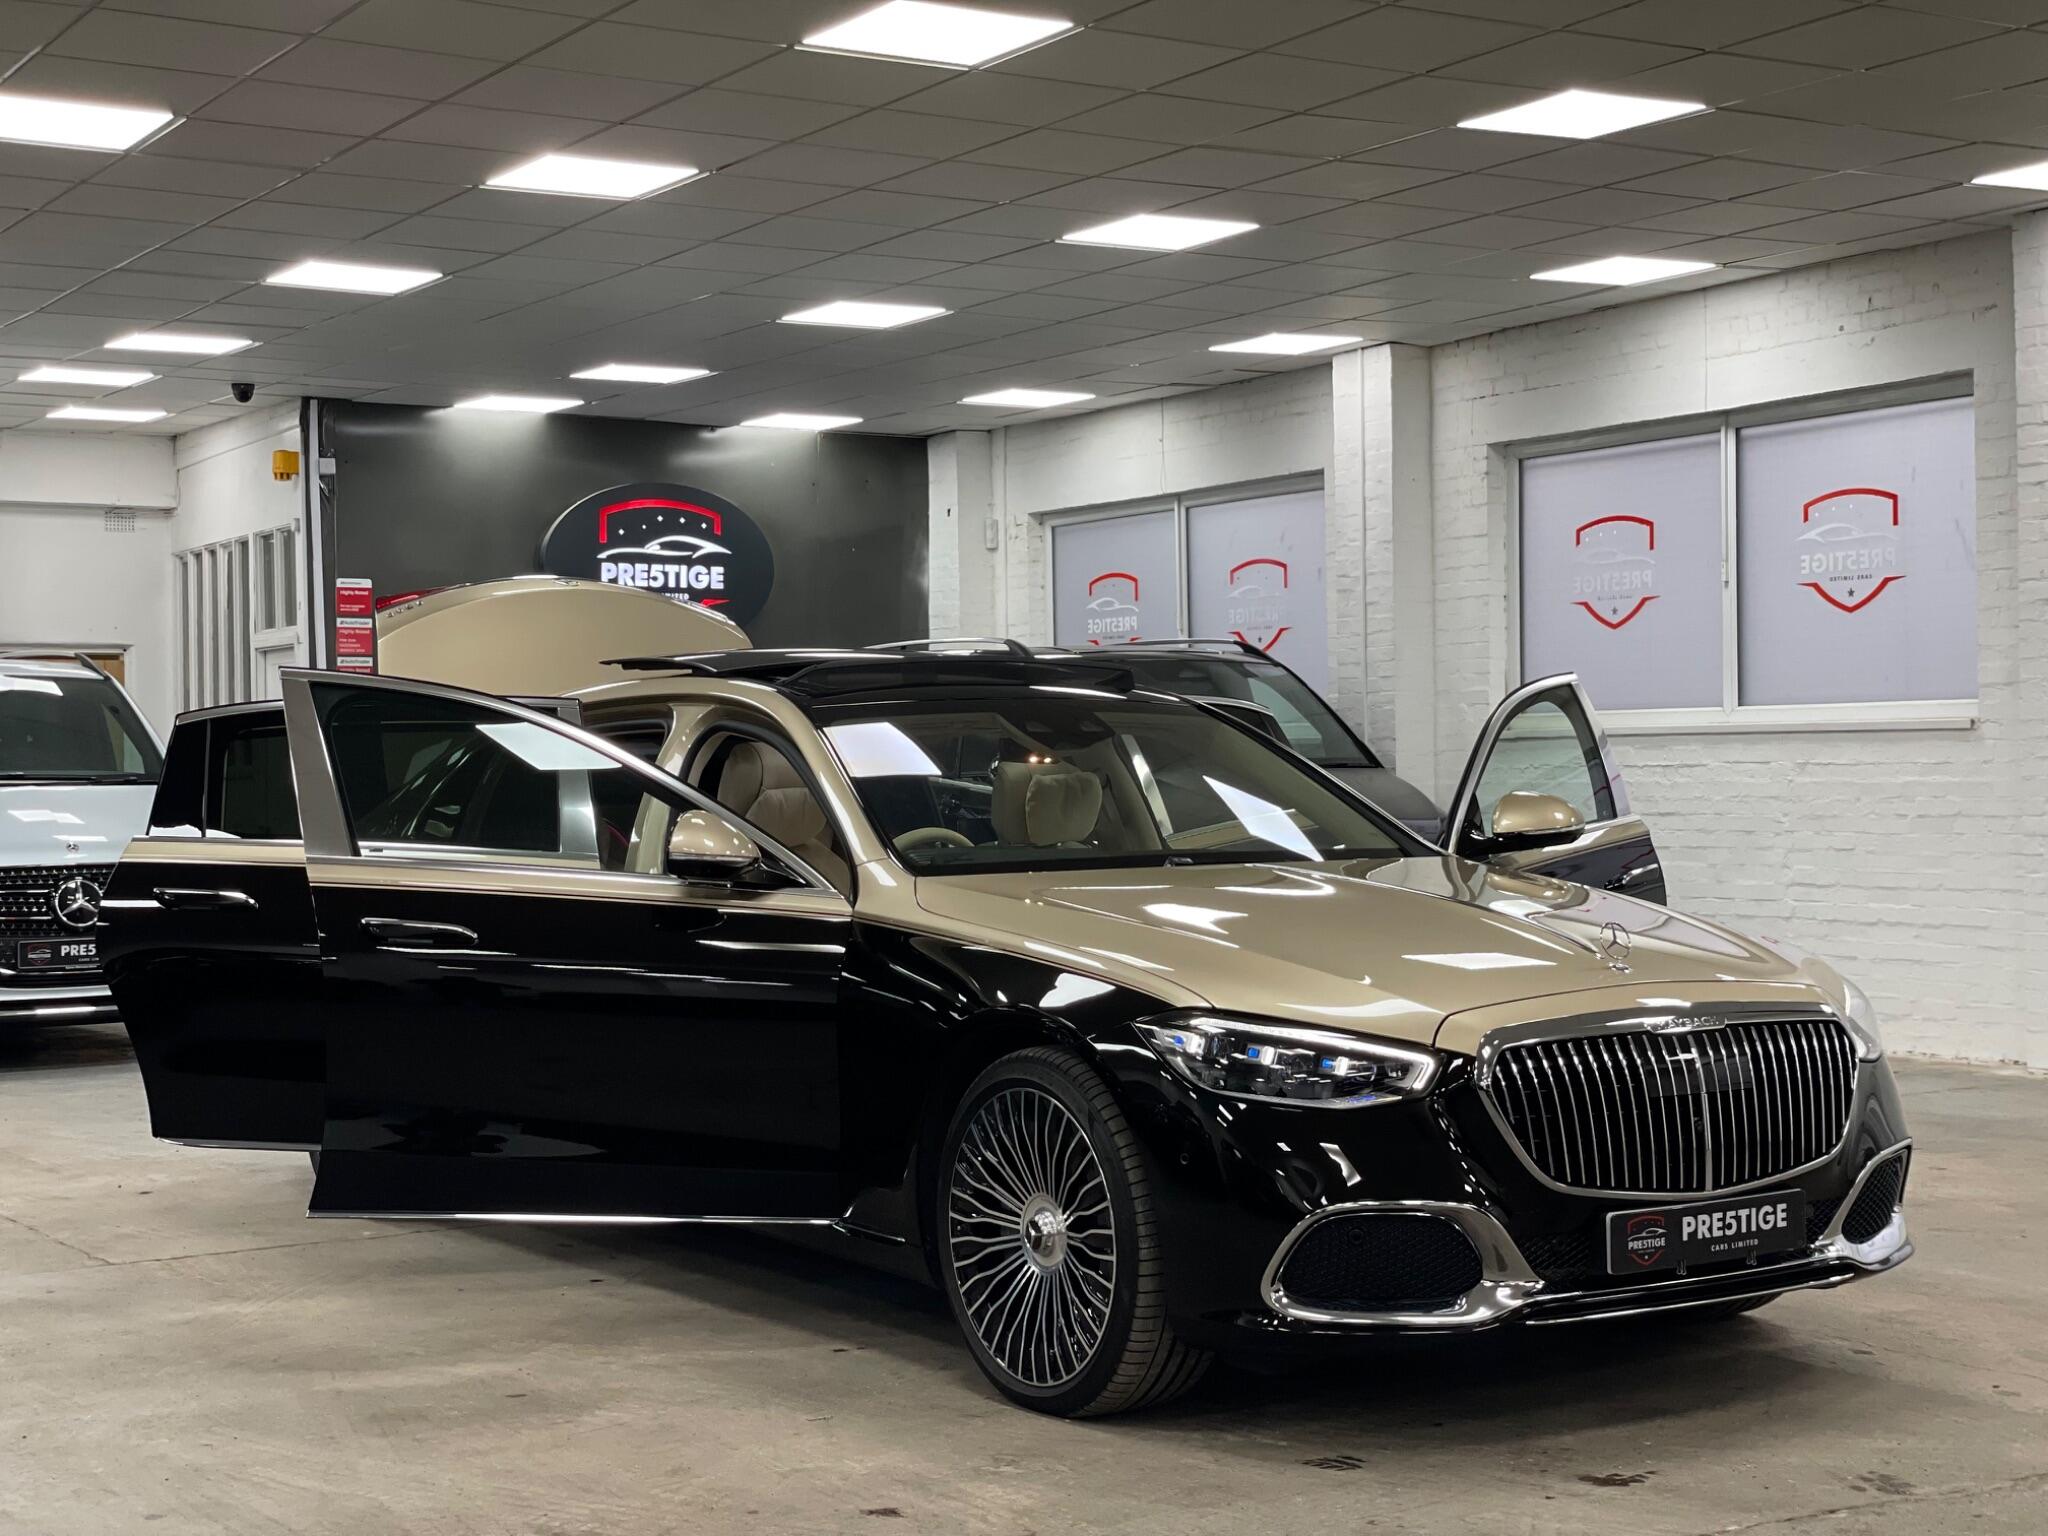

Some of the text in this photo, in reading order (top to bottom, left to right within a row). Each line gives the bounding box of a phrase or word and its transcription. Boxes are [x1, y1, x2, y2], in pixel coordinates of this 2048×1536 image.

[600, 562, 724, 589] PRE5TIGE
[1682, 1203, 1788, 1241] PRE5TIGE
[1731, 1238, 1759, 1249] LIMITED
